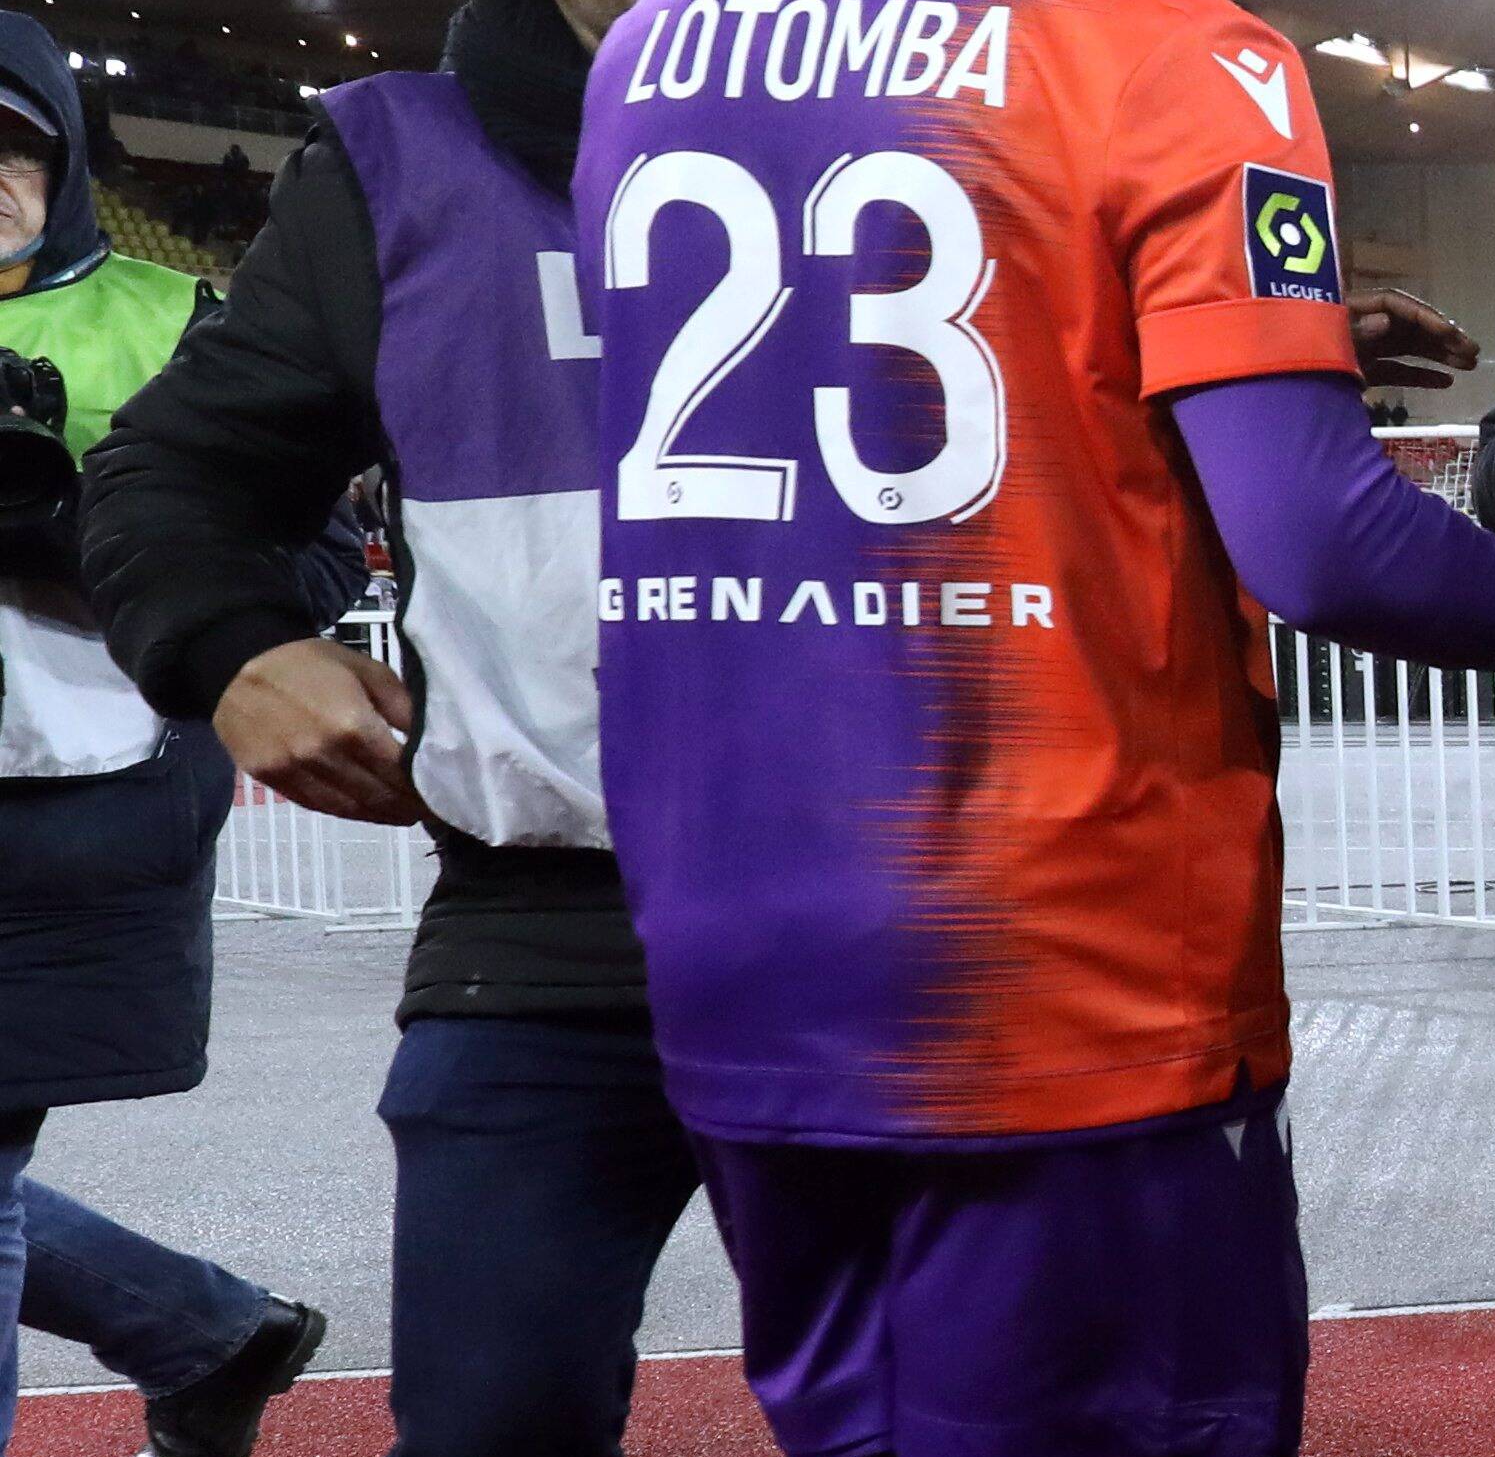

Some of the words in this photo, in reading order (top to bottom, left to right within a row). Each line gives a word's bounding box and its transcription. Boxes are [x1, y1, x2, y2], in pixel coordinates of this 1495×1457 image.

[1270, 282, 1324, 303] LIGUE
[603, 149, 1007, 526] 23
[599, 575, 1055, 629] GRENADIER
